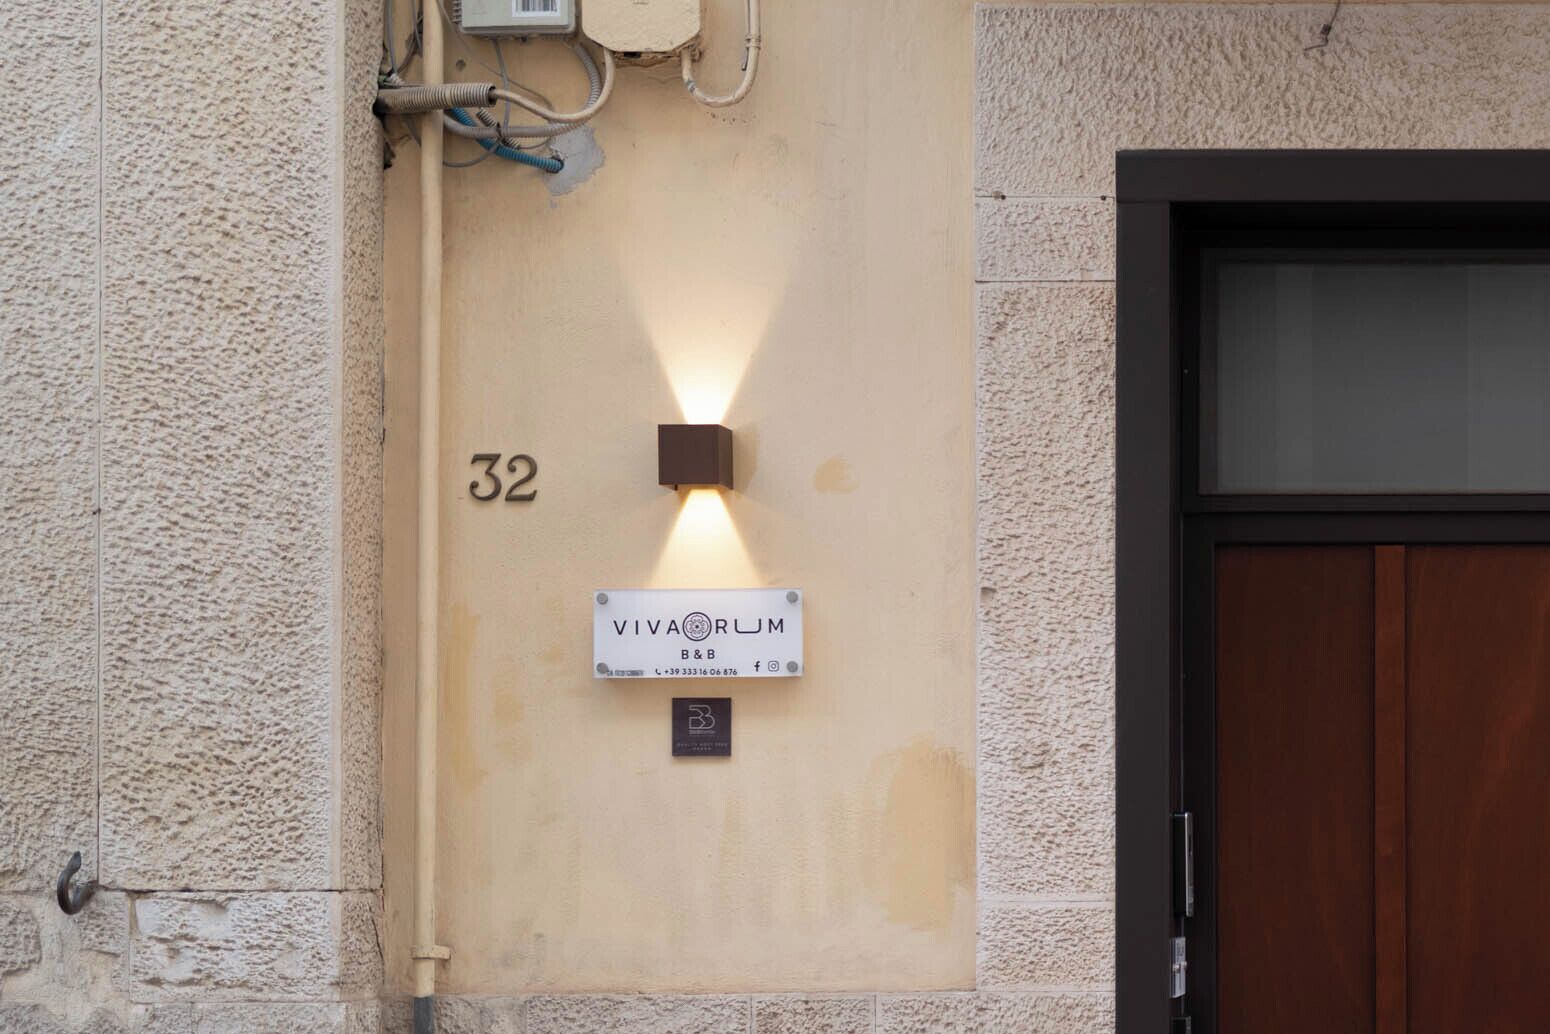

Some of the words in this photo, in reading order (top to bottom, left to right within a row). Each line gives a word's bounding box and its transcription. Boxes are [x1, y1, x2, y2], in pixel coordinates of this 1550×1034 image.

[468, 453, 538, 502] 32
[682, 668, 698, 676] 333
[709, 668, 721, 676] 06
